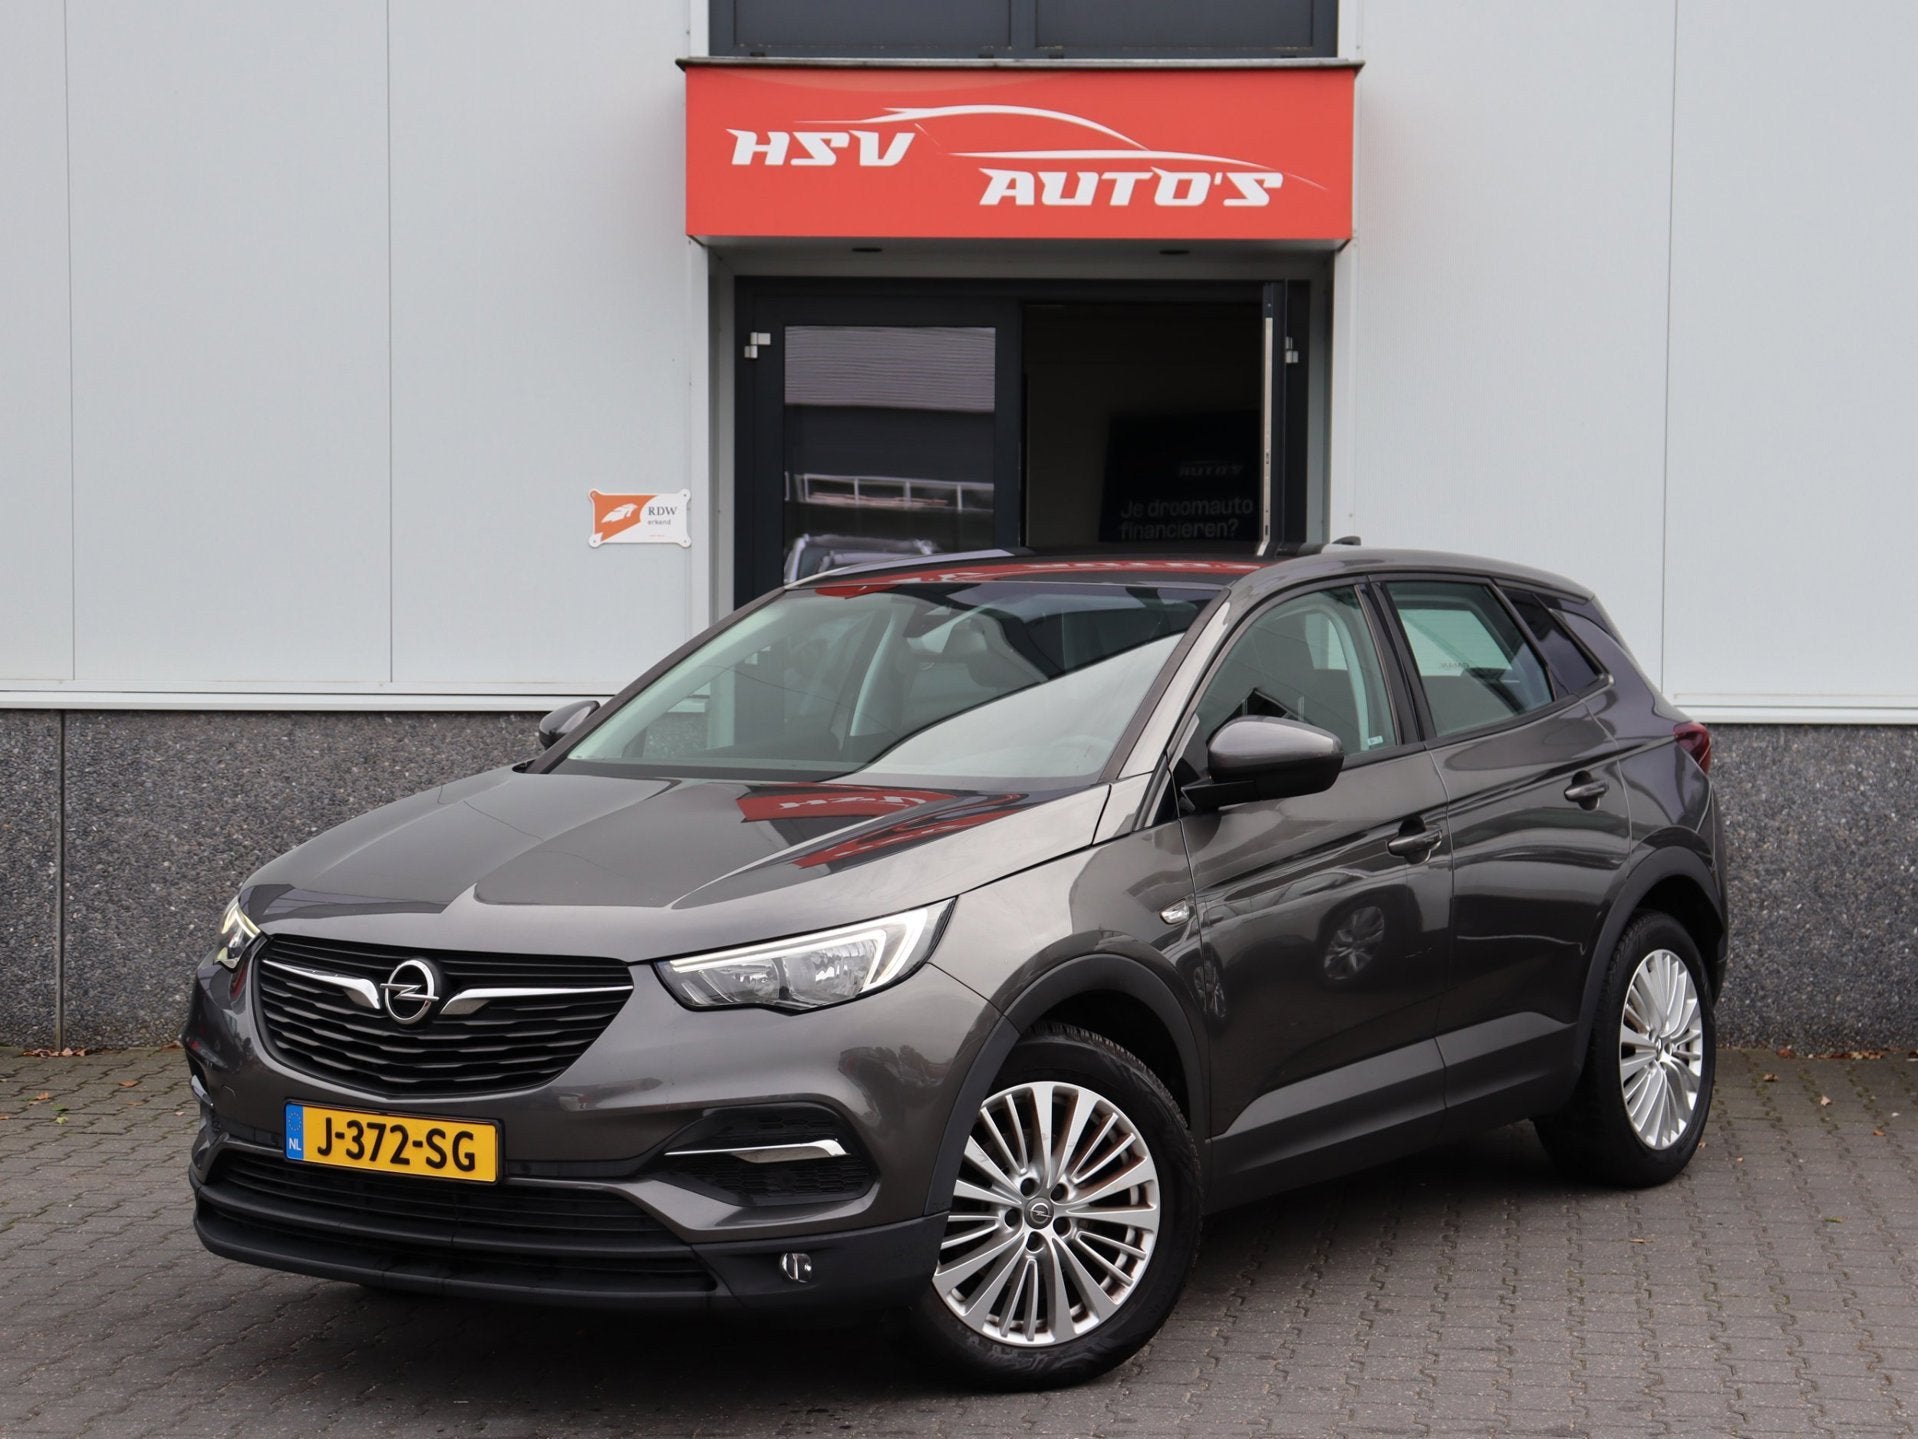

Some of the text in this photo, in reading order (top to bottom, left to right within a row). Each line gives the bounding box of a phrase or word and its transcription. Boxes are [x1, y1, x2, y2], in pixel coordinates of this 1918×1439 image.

[726, 129, 915, 167] HSV
[979, 166, 1284, 207] AUTO'S
[648, 506, 677, 516] RDW
[1121, 498, 1254, 518] Je droomauto
[1120, 519, 1238, 540] financieren?
[289, 1138, 301, 1150] NL
[317, 1116, 476, 1172] J-372-SG
